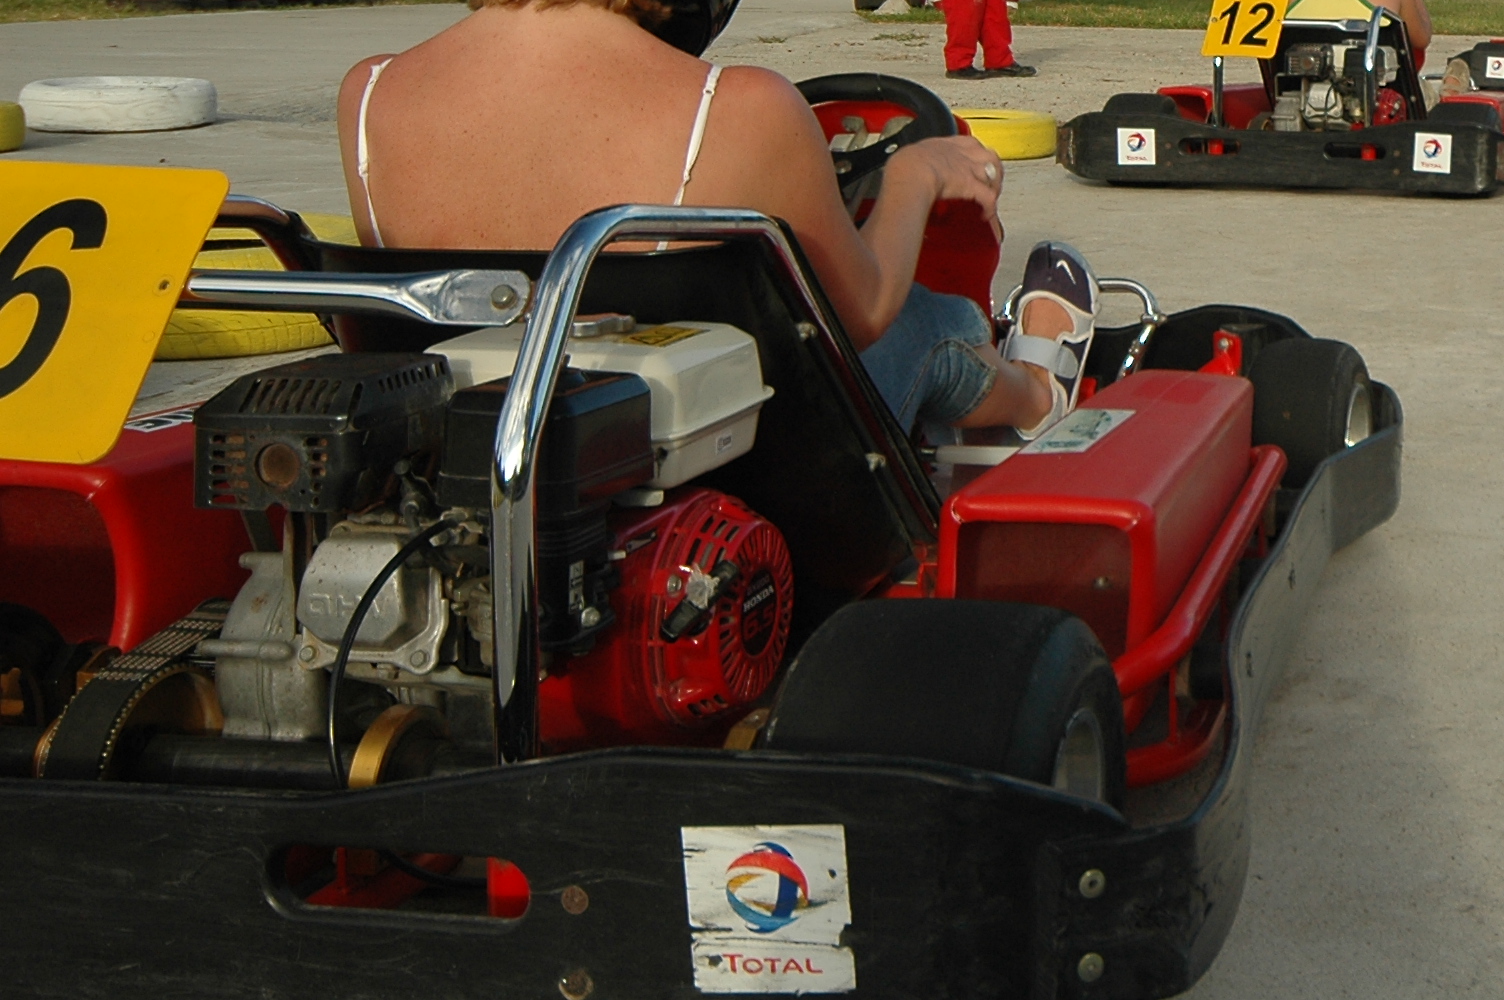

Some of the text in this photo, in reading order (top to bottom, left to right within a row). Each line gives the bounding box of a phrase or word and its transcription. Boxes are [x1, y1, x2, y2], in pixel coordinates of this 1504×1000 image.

[1219, 0, 1275, 47] 12
[0, 198, 109, 400] 6
[743, 584, 775, 613] HONDA
[722, 953, 824, 976] TOTAL
